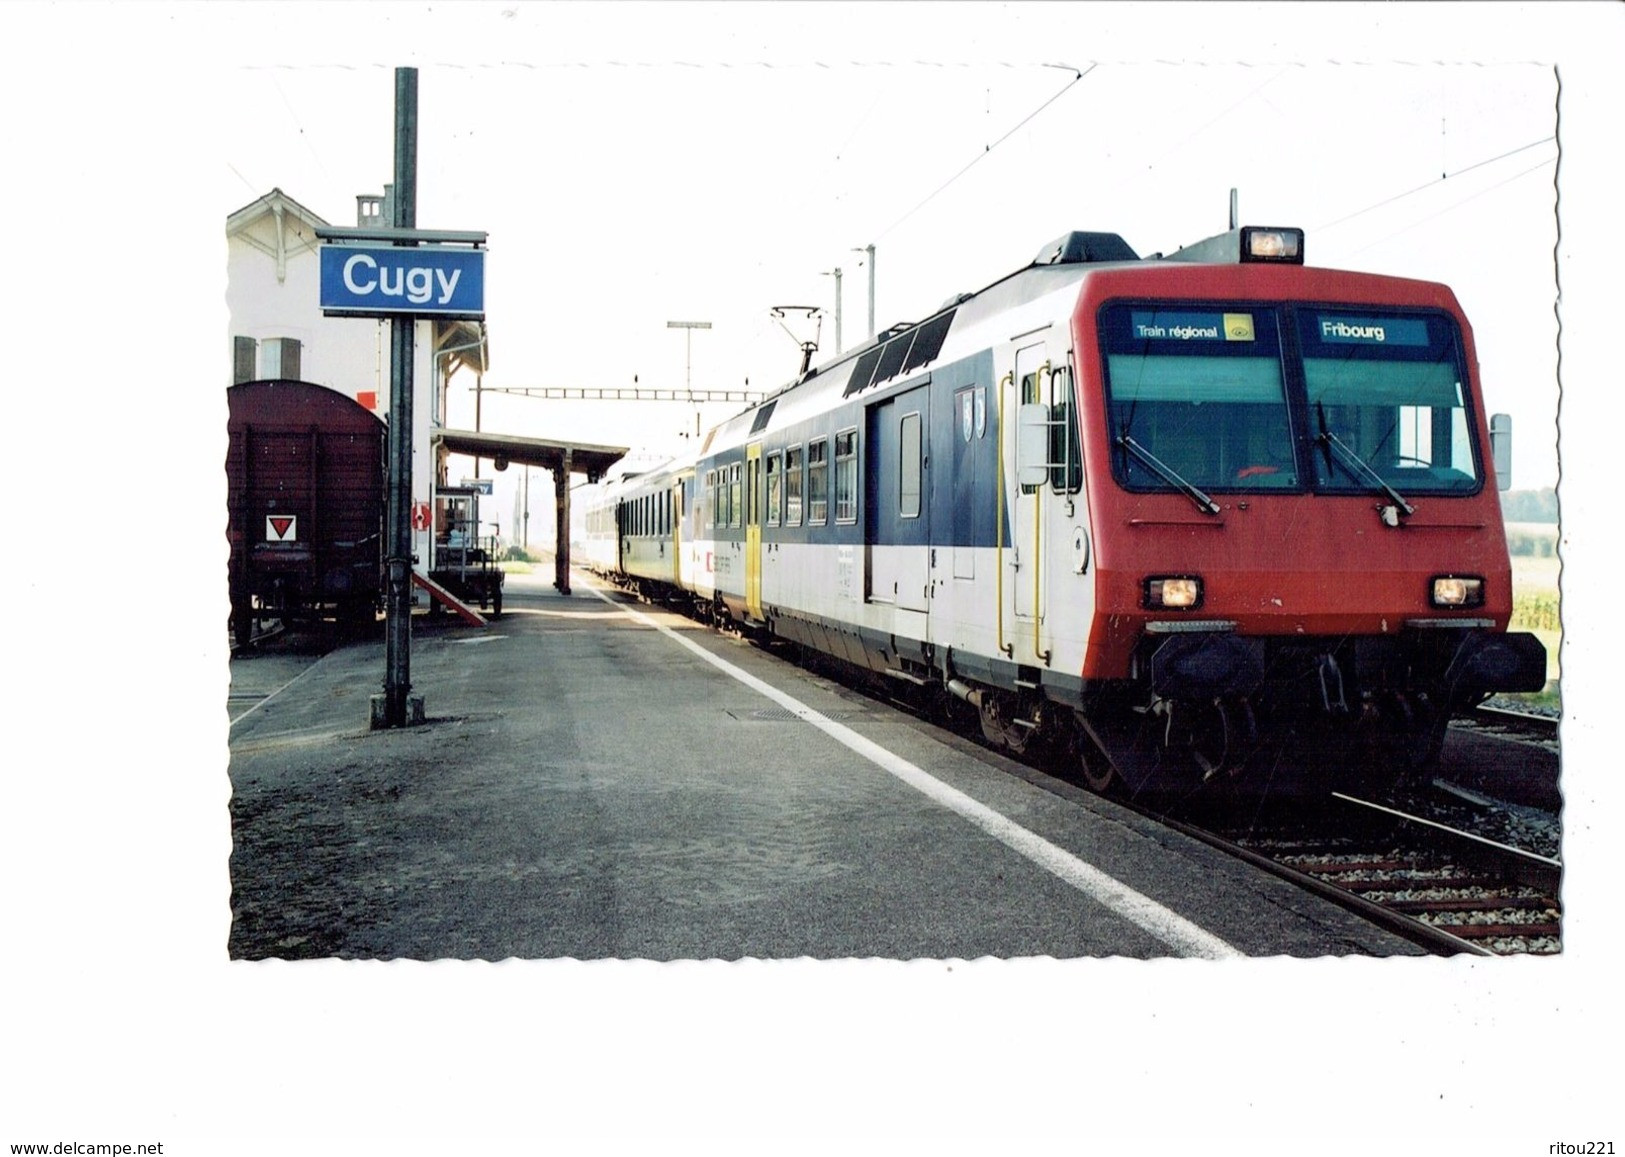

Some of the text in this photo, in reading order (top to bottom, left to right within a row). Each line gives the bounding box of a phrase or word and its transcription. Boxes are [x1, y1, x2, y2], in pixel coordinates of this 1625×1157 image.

[343, 253, 462, 304] Cugy
[1137, 325, 1218, 339] Train régional
[1322, 322, 1385, 341] Fribourg
